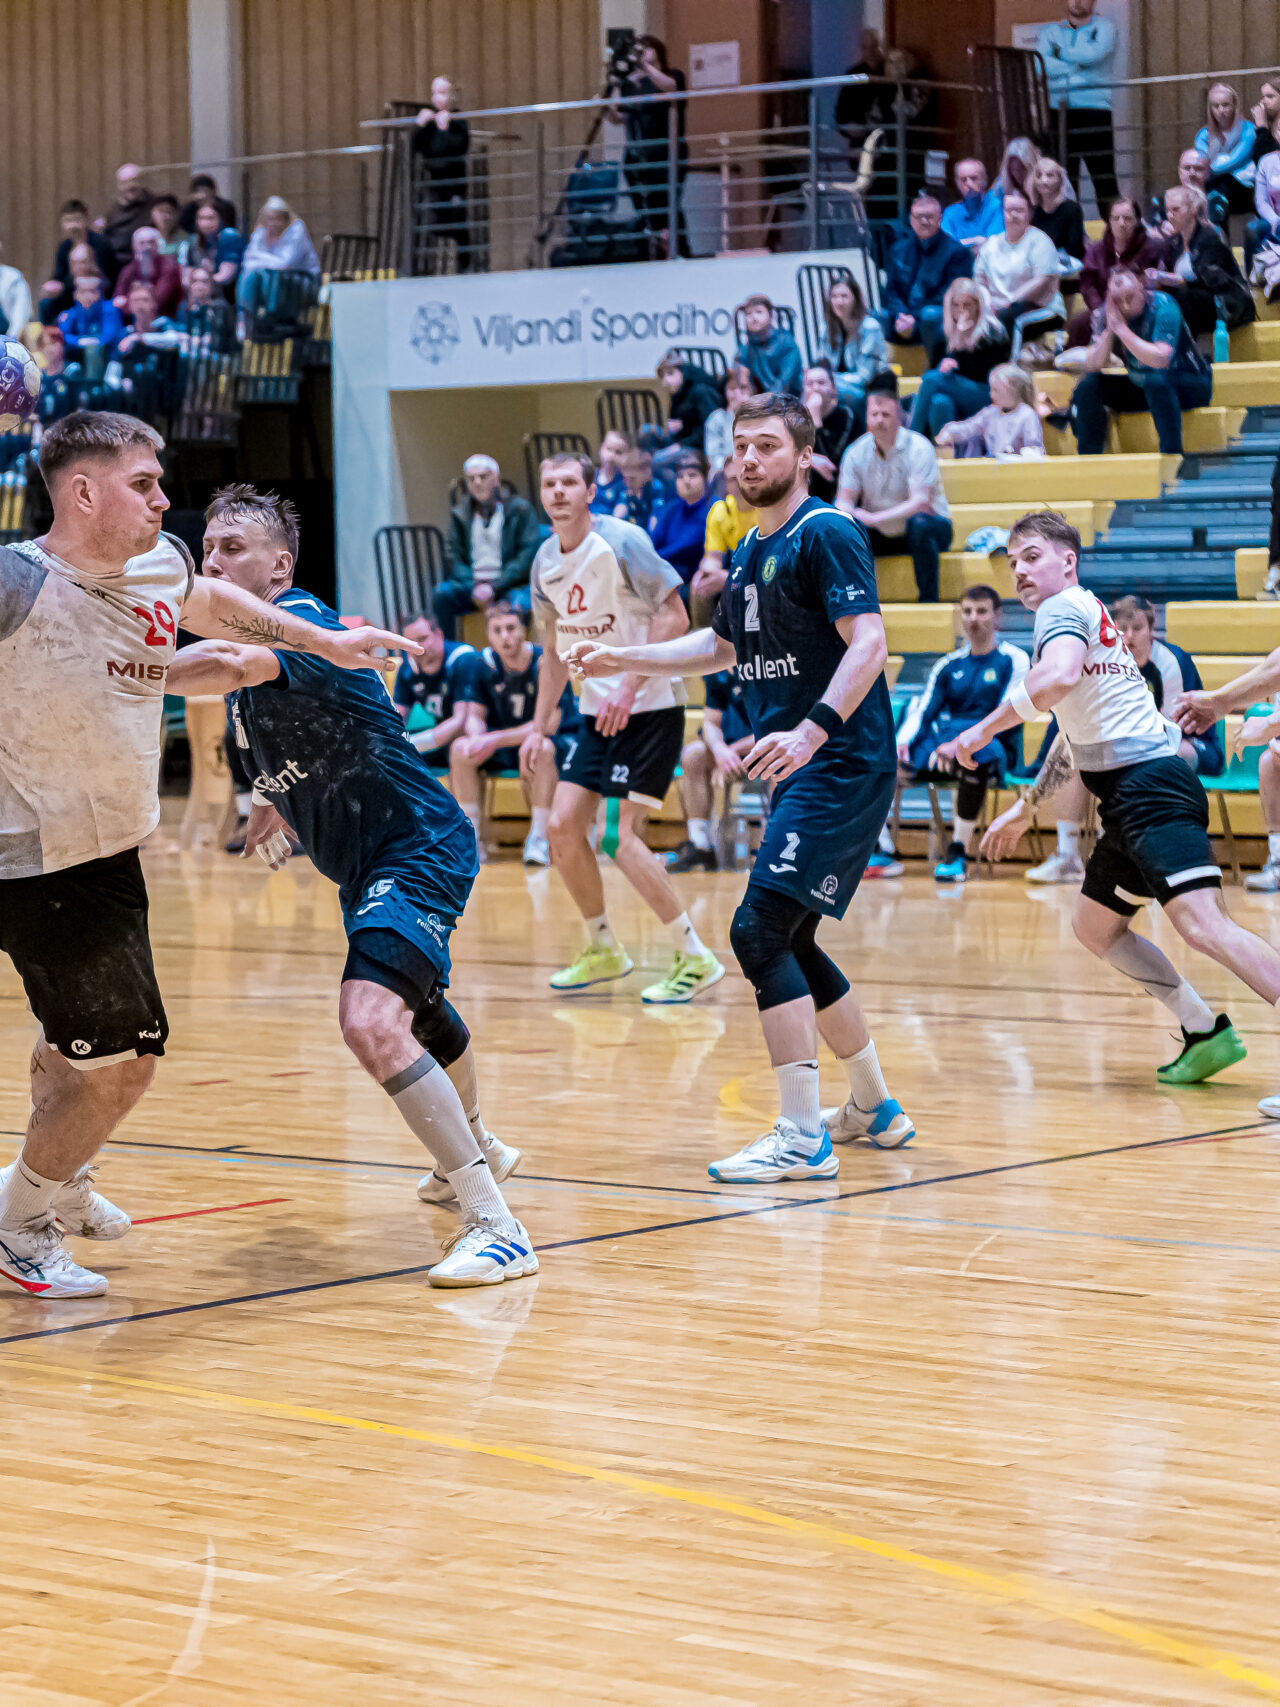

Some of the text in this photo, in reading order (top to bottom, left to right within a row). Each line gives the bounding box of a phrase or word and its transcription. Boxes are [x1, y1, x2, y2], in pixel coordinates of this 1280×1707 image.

[473, 303, 732, 353] Viljandi Spordiho
[567, 584, 588, 614] 22
[744, 583, 761, 632] 2
[132, 600, 176, 647] 29
[106, 661, 170, 681] MIS
[610, 764, 630, 783] 22
[779, 832, 801, 861] 2
[367, 878, 395, 899] 15
